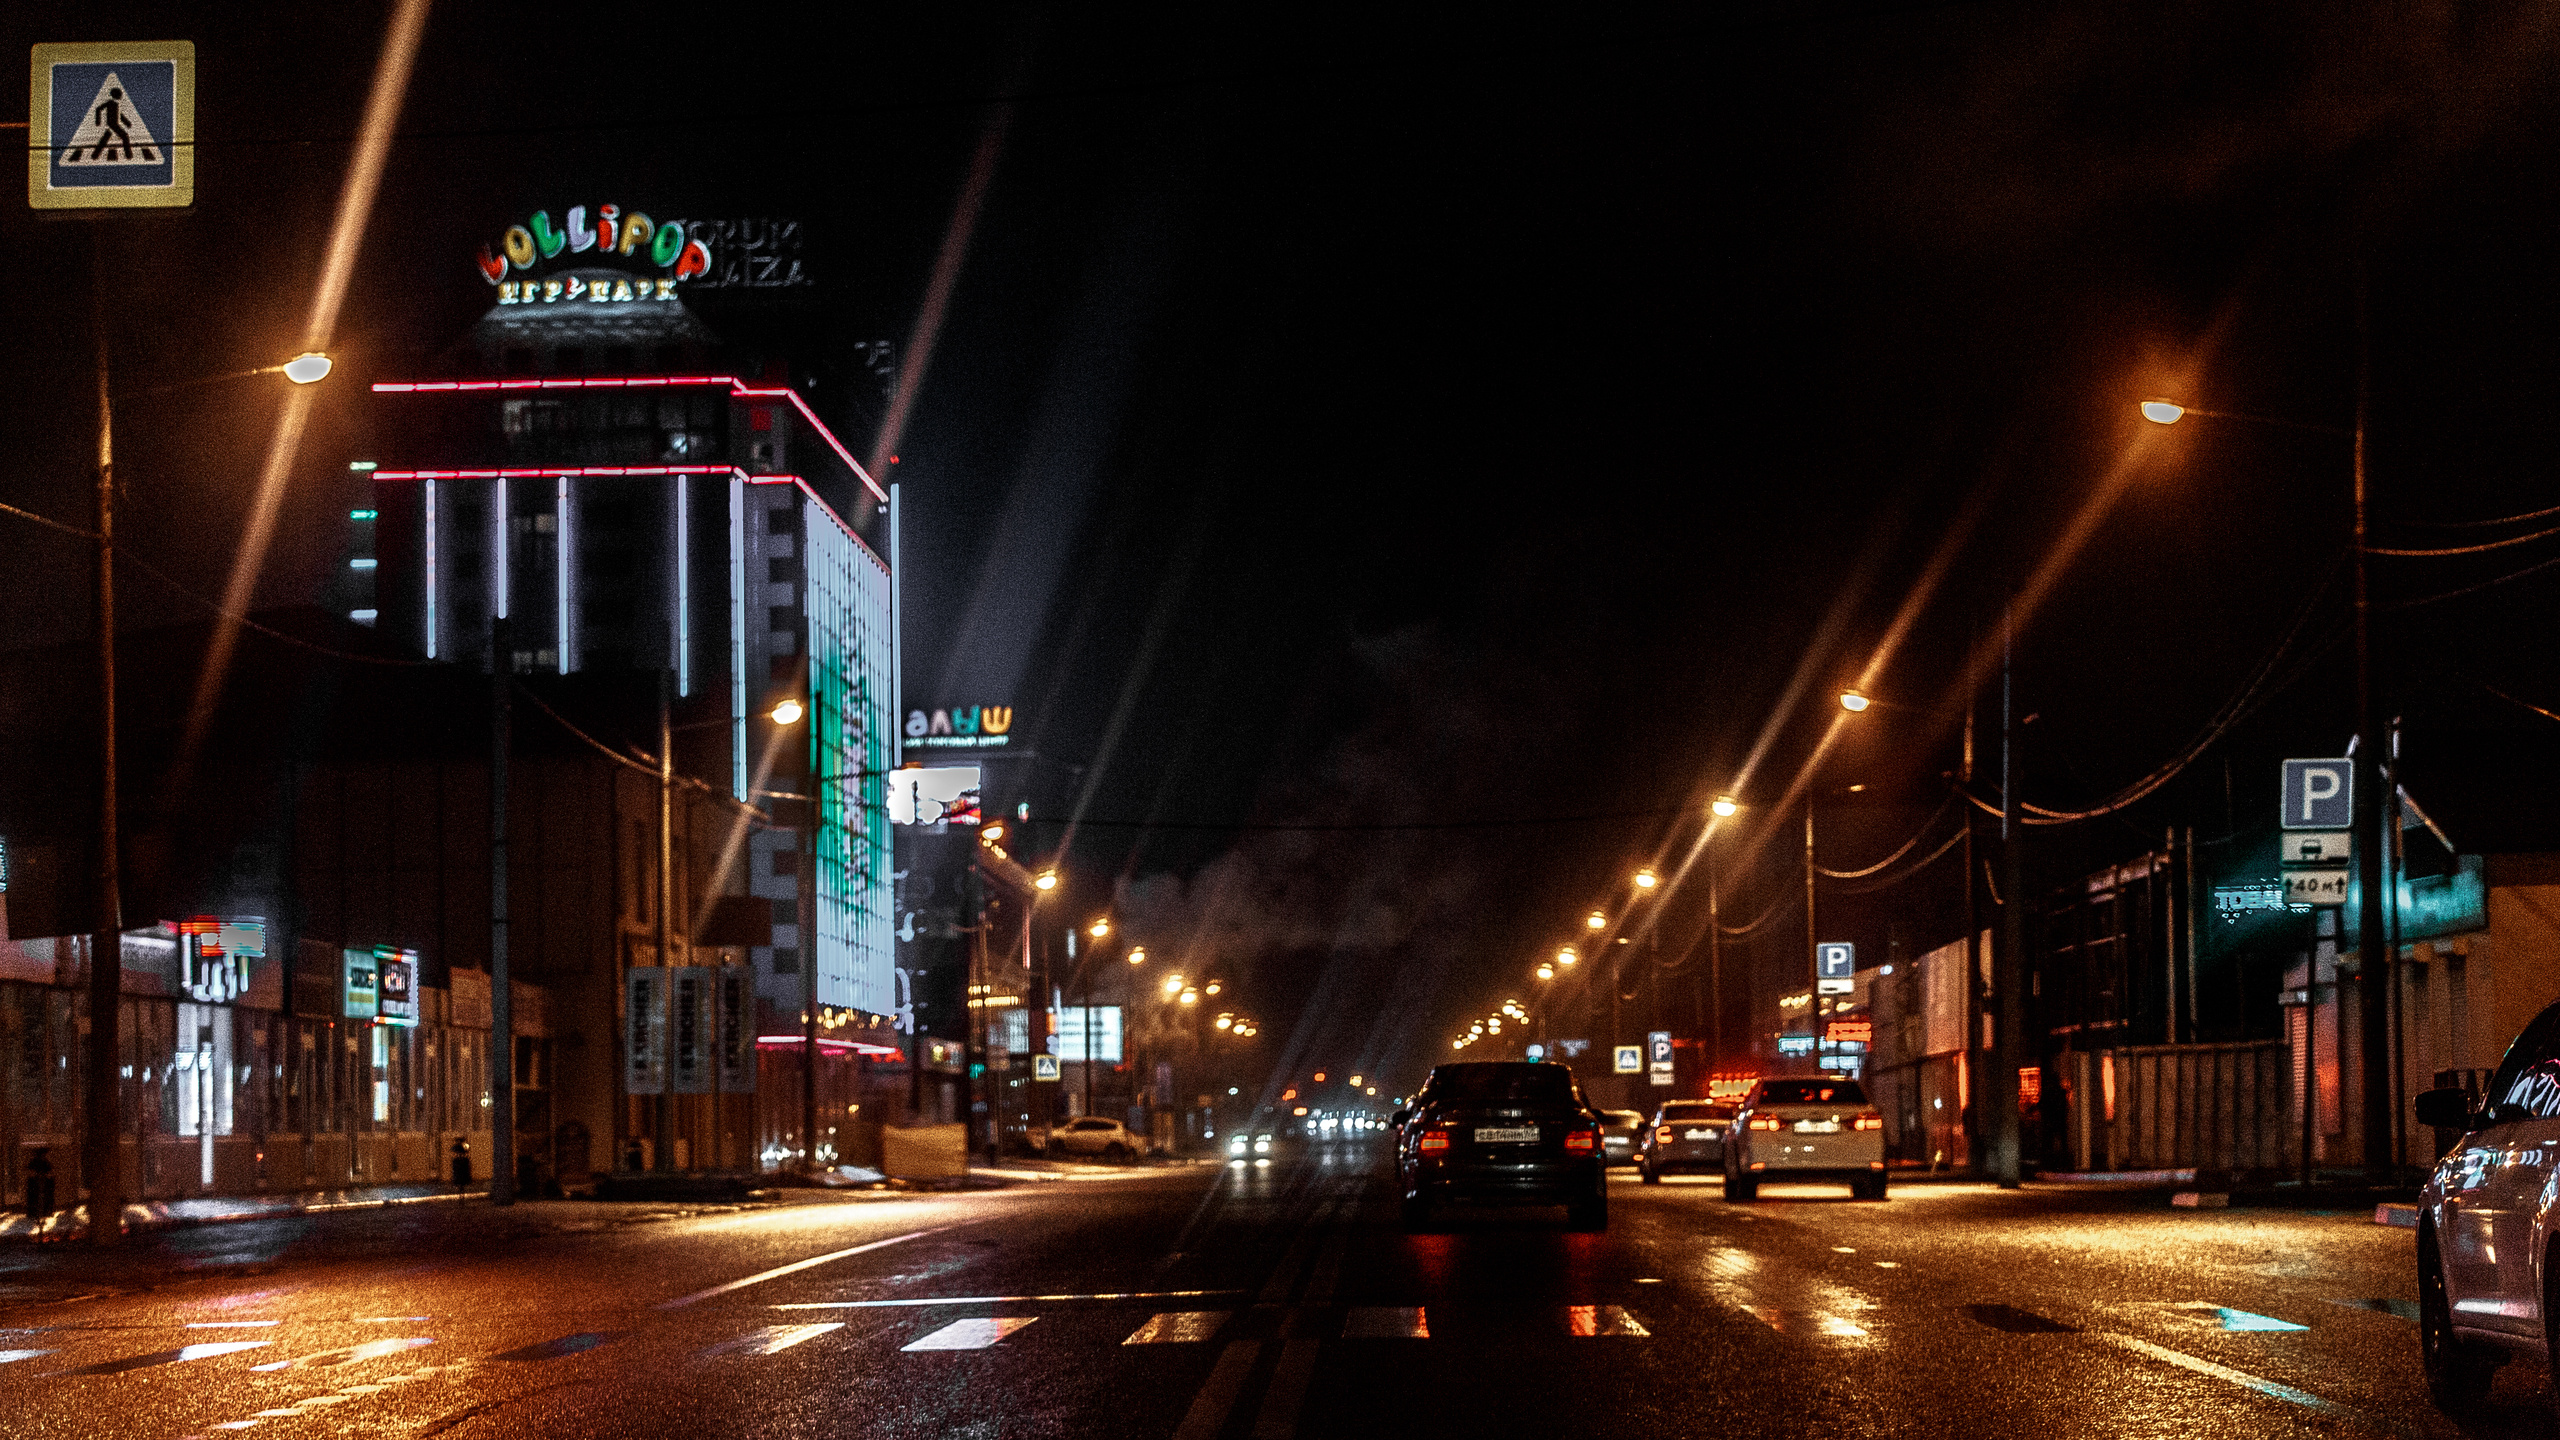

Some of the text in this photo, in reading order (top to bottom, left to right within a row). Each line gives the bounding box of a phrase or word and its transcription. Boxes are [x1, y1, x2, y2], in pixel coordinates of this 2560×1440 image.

[905, 705, 1013, 737] алыш
[2303, 768, 2341, 820] P
[2295, 878, 2319, 892] 40
[1827, 947, 1848, 975] P
[1655, 1042, 1671, 1060] P
